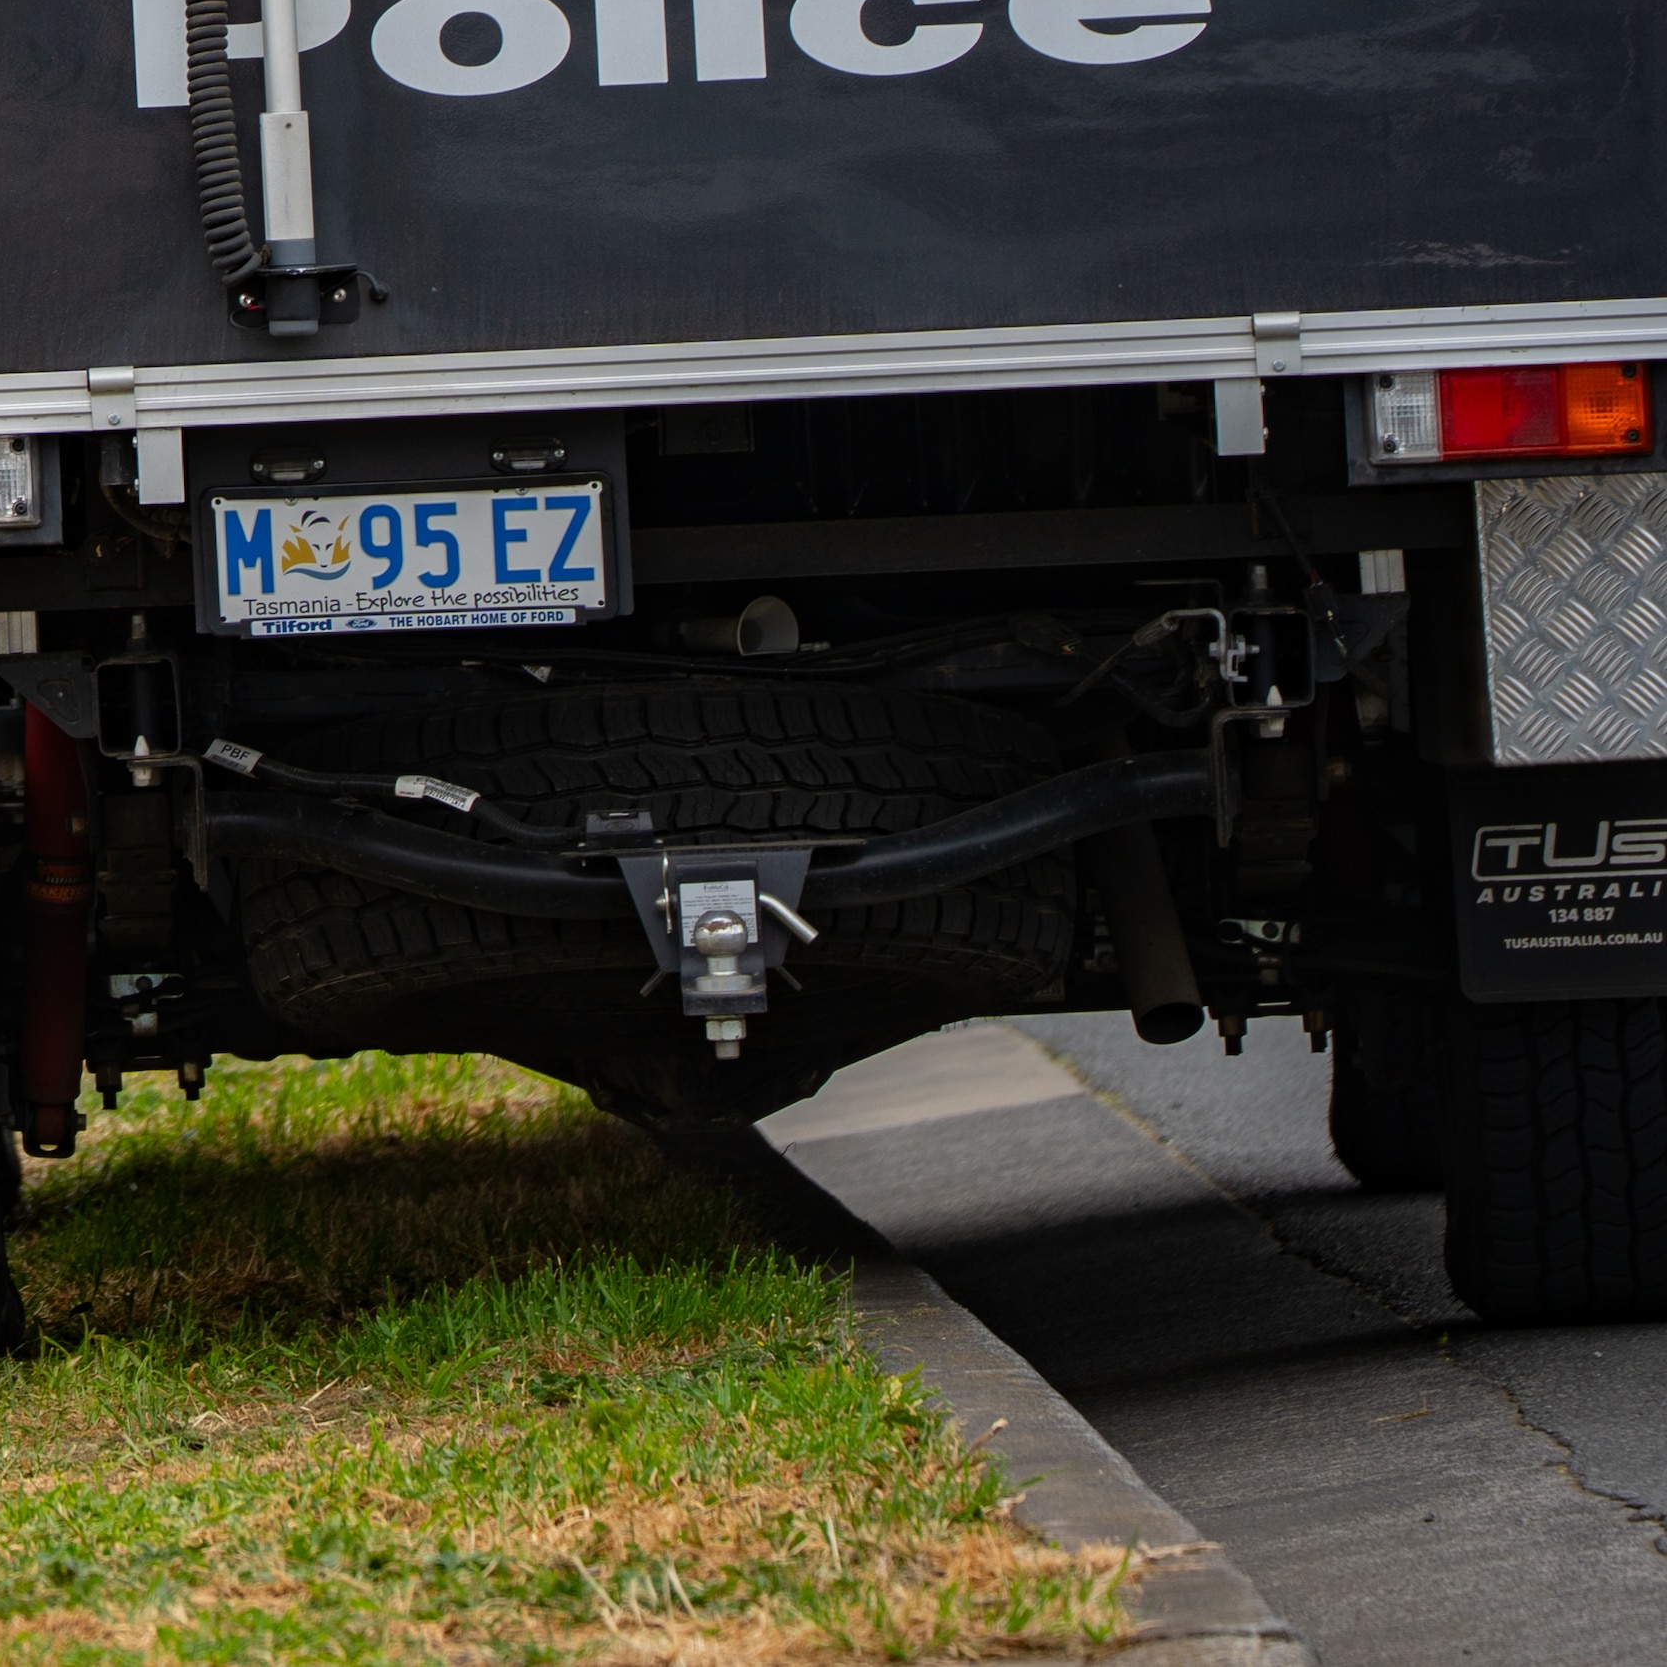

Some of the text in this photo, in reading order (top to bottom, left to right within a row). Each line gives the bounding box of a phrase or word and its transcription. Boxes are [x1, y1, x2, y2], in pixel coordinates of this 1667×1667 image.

[224, 495, 596, 595] M 95 EZ
[243, 596, 341, 616] Tasmania
[355, 590, 426, 612] Explore
[431, 588, 468, 607] the
[473, 584, 579, 609] possibilities
[262, 619, 333, 634] Tilford
[389, 616, 414, 627] THE
[417, 614, 468, 626] HOBART
[471, 612, 507, 625] HOME
[511, 612, 527, 623] OF
[531, 610, 564, 623] FORD
[220, 744, 251, 761] PBF
[1485, 821, 1667, 869] TUS
[1476, 881, 1663, 904] AUSTRALI
[1548, 907, 1615, 923] 134 887
[1503, 932, 1664, 950] TUSAUSTRALIA.COM.AU
